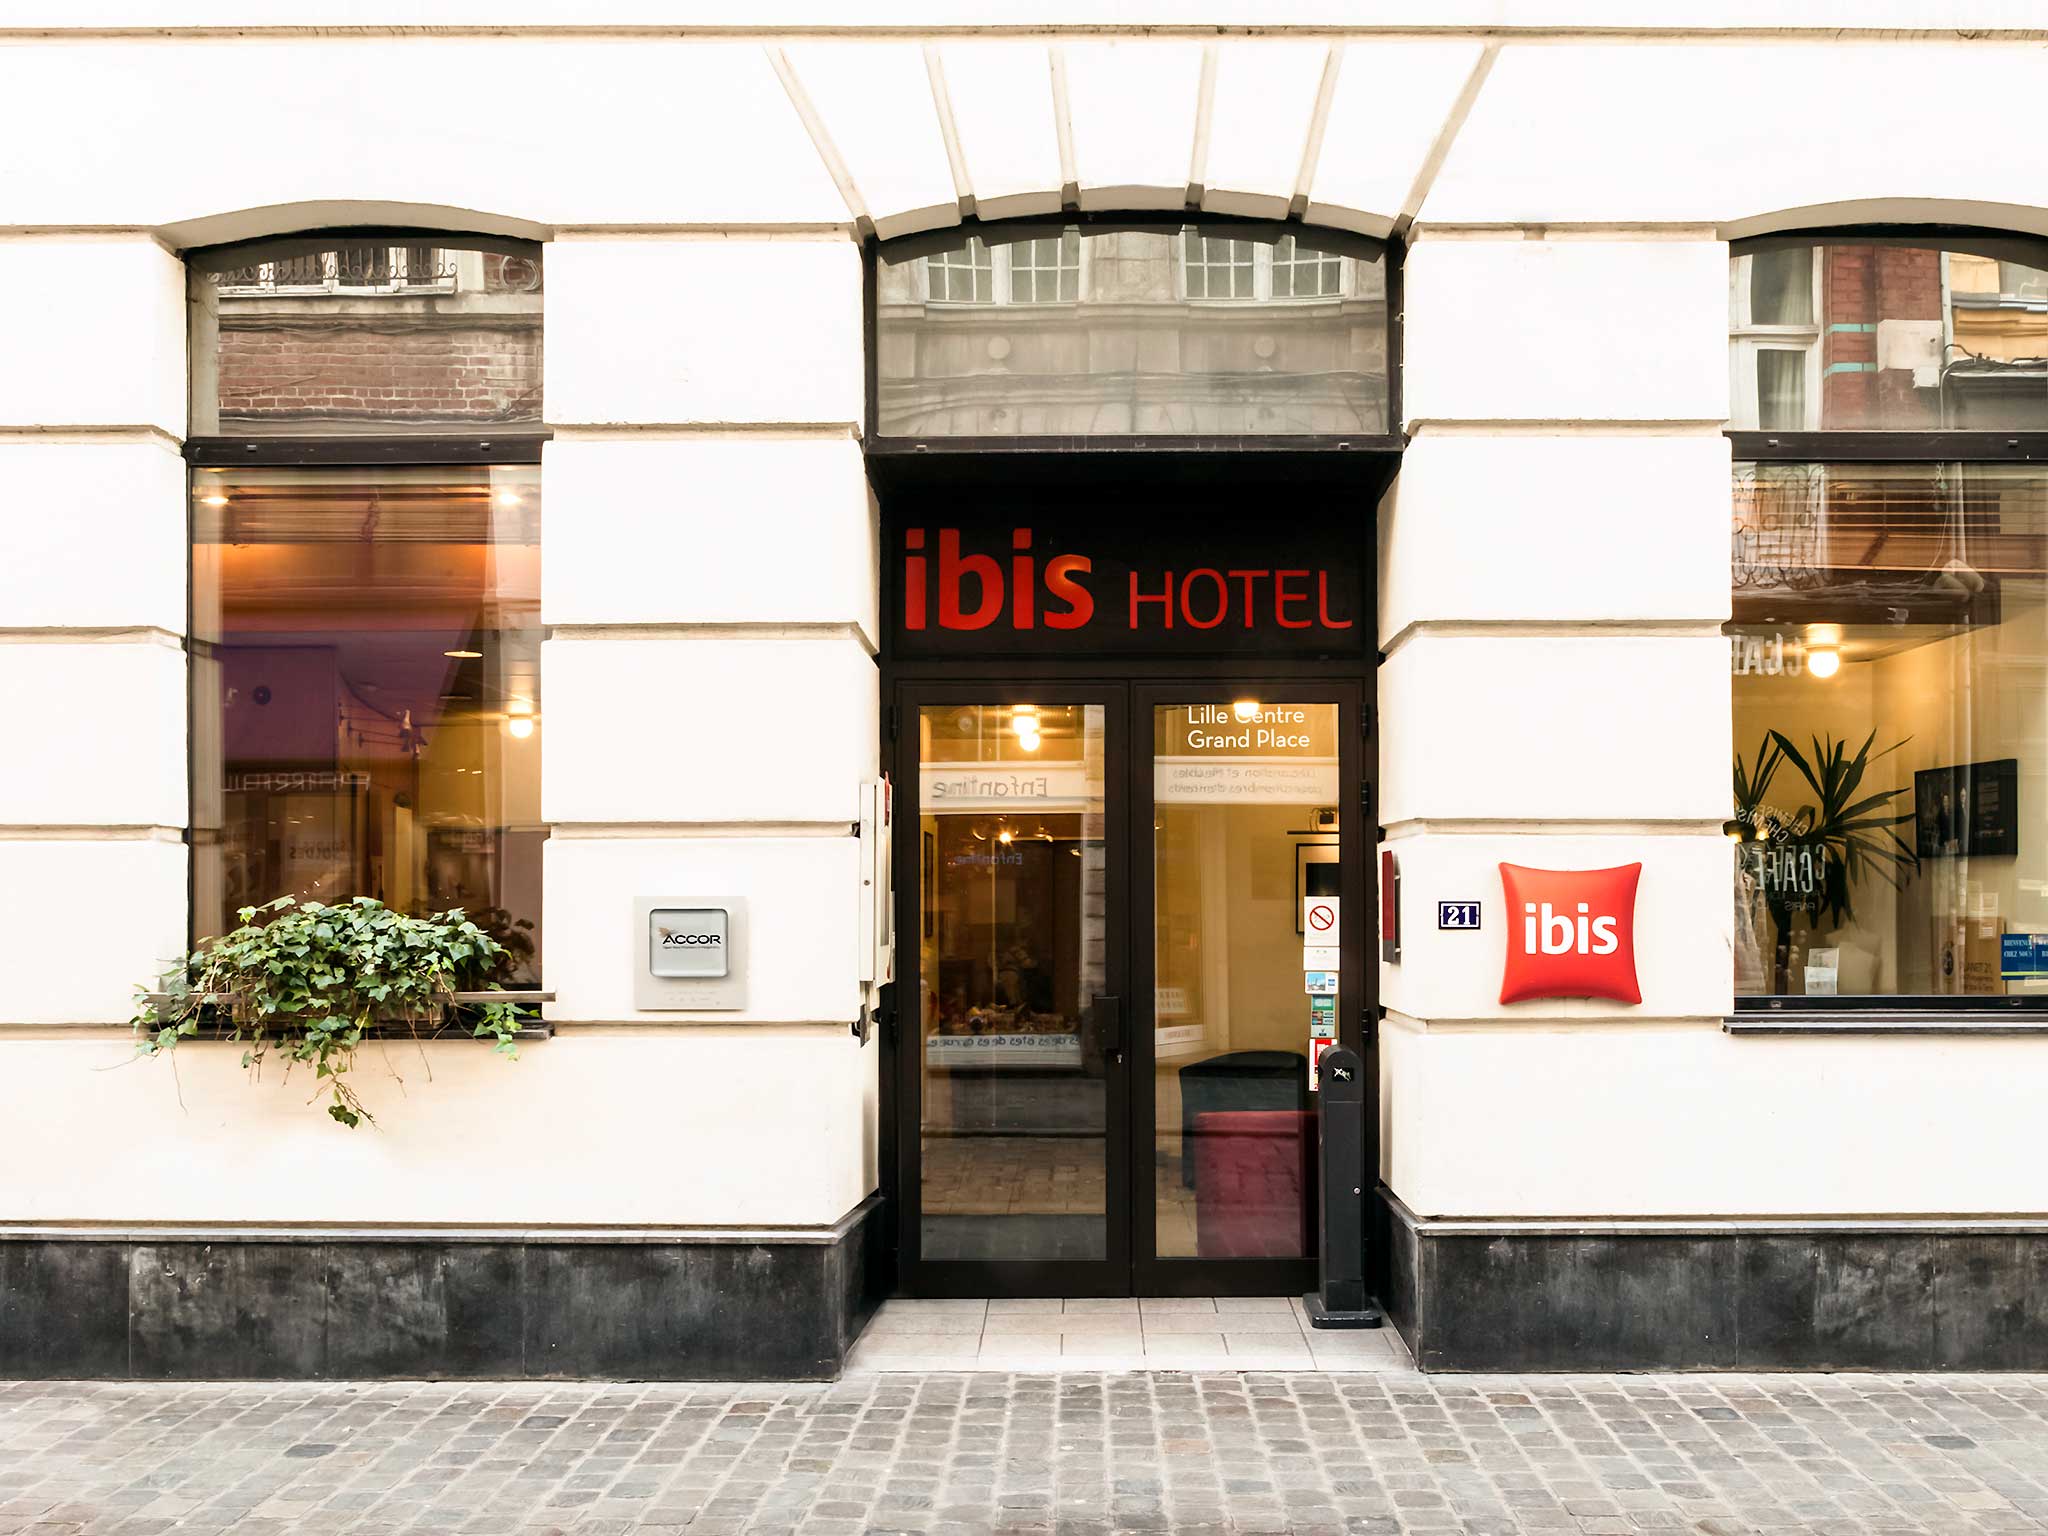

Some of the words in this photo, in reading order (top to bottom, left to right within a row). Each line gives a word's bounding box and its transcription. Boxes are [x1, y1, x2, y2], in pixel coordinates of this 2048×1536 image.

[905, 528, 1094, 630] ibis
[1129, 568, 1353, 630] HOTEL
[1188, 706, 1228, 725] Lille
[1187, 730, 1251, 749] Grand
[1257, 729, 1311, 749] Place
[1447, 906, 1471, 926] 21
[1524, 902, 1619, 955] ibis
[662, 934, 722, 945] ACCOR
